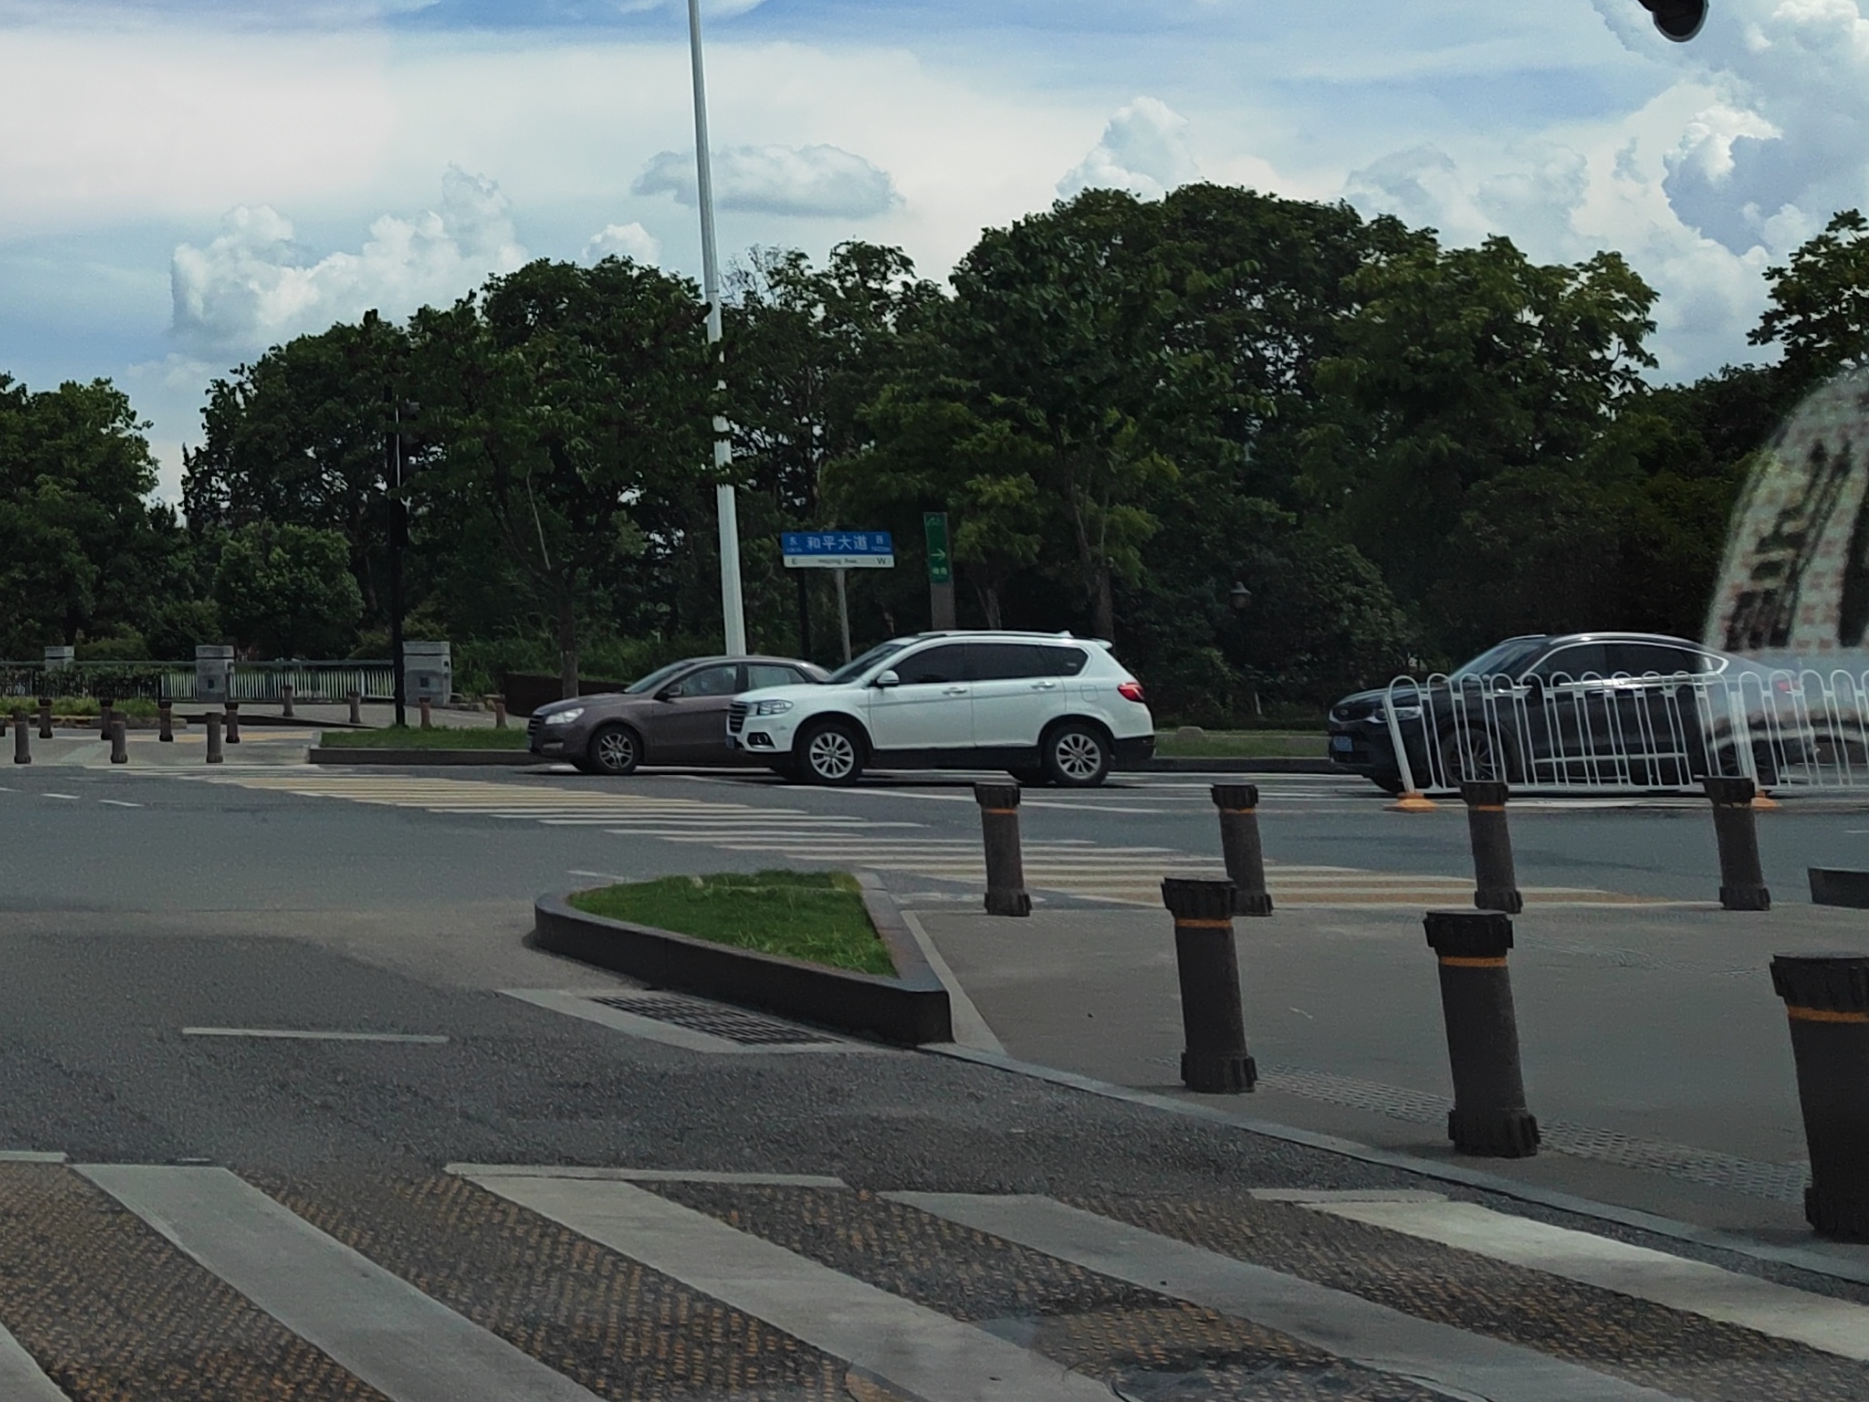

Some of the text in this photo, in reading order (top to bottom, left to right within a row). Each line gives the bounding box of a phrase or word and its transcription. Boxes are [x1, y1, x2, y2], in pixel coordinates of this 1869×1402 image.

[806, 534, 868, 551] 和平大道
[876, 557, 887, 565] W
